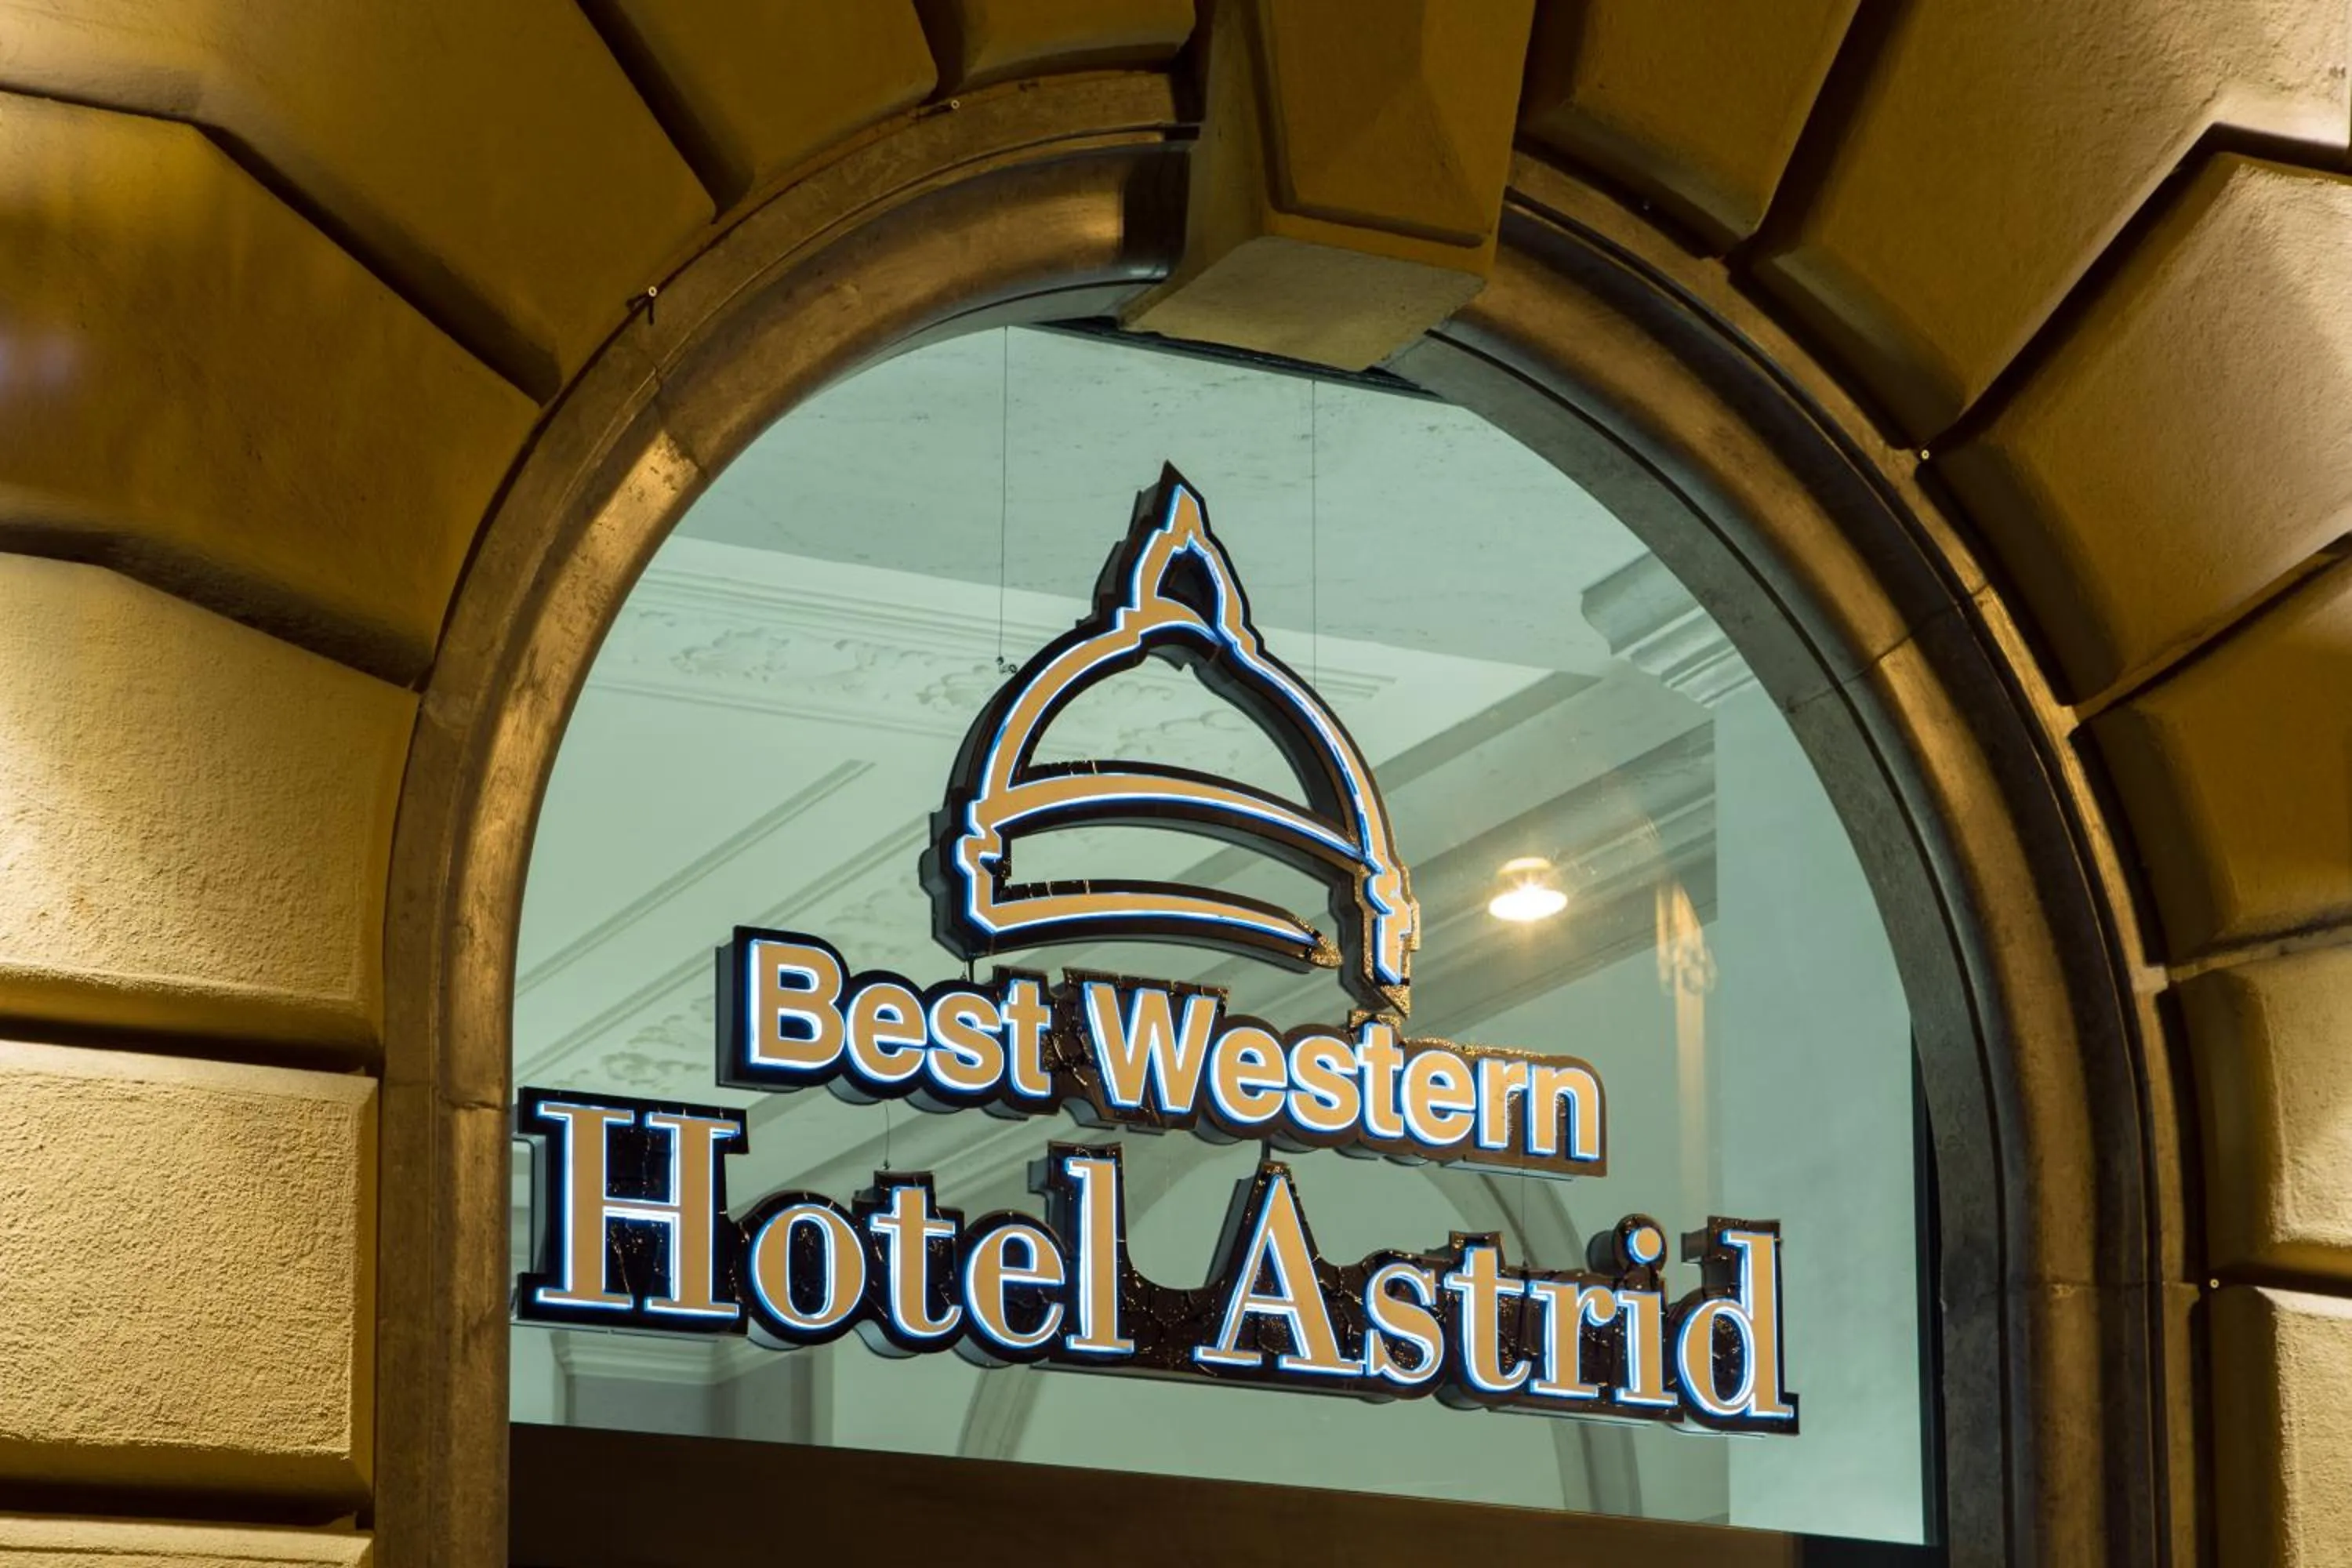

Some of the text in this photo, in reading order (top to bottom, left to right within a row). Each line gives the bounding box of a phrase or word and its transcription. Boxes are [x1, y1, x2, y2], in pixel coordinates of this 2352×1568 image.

[750, 938, 1601, 1160] Best Western
[535, 1102, 1795, 1418] Hotel Astrid
